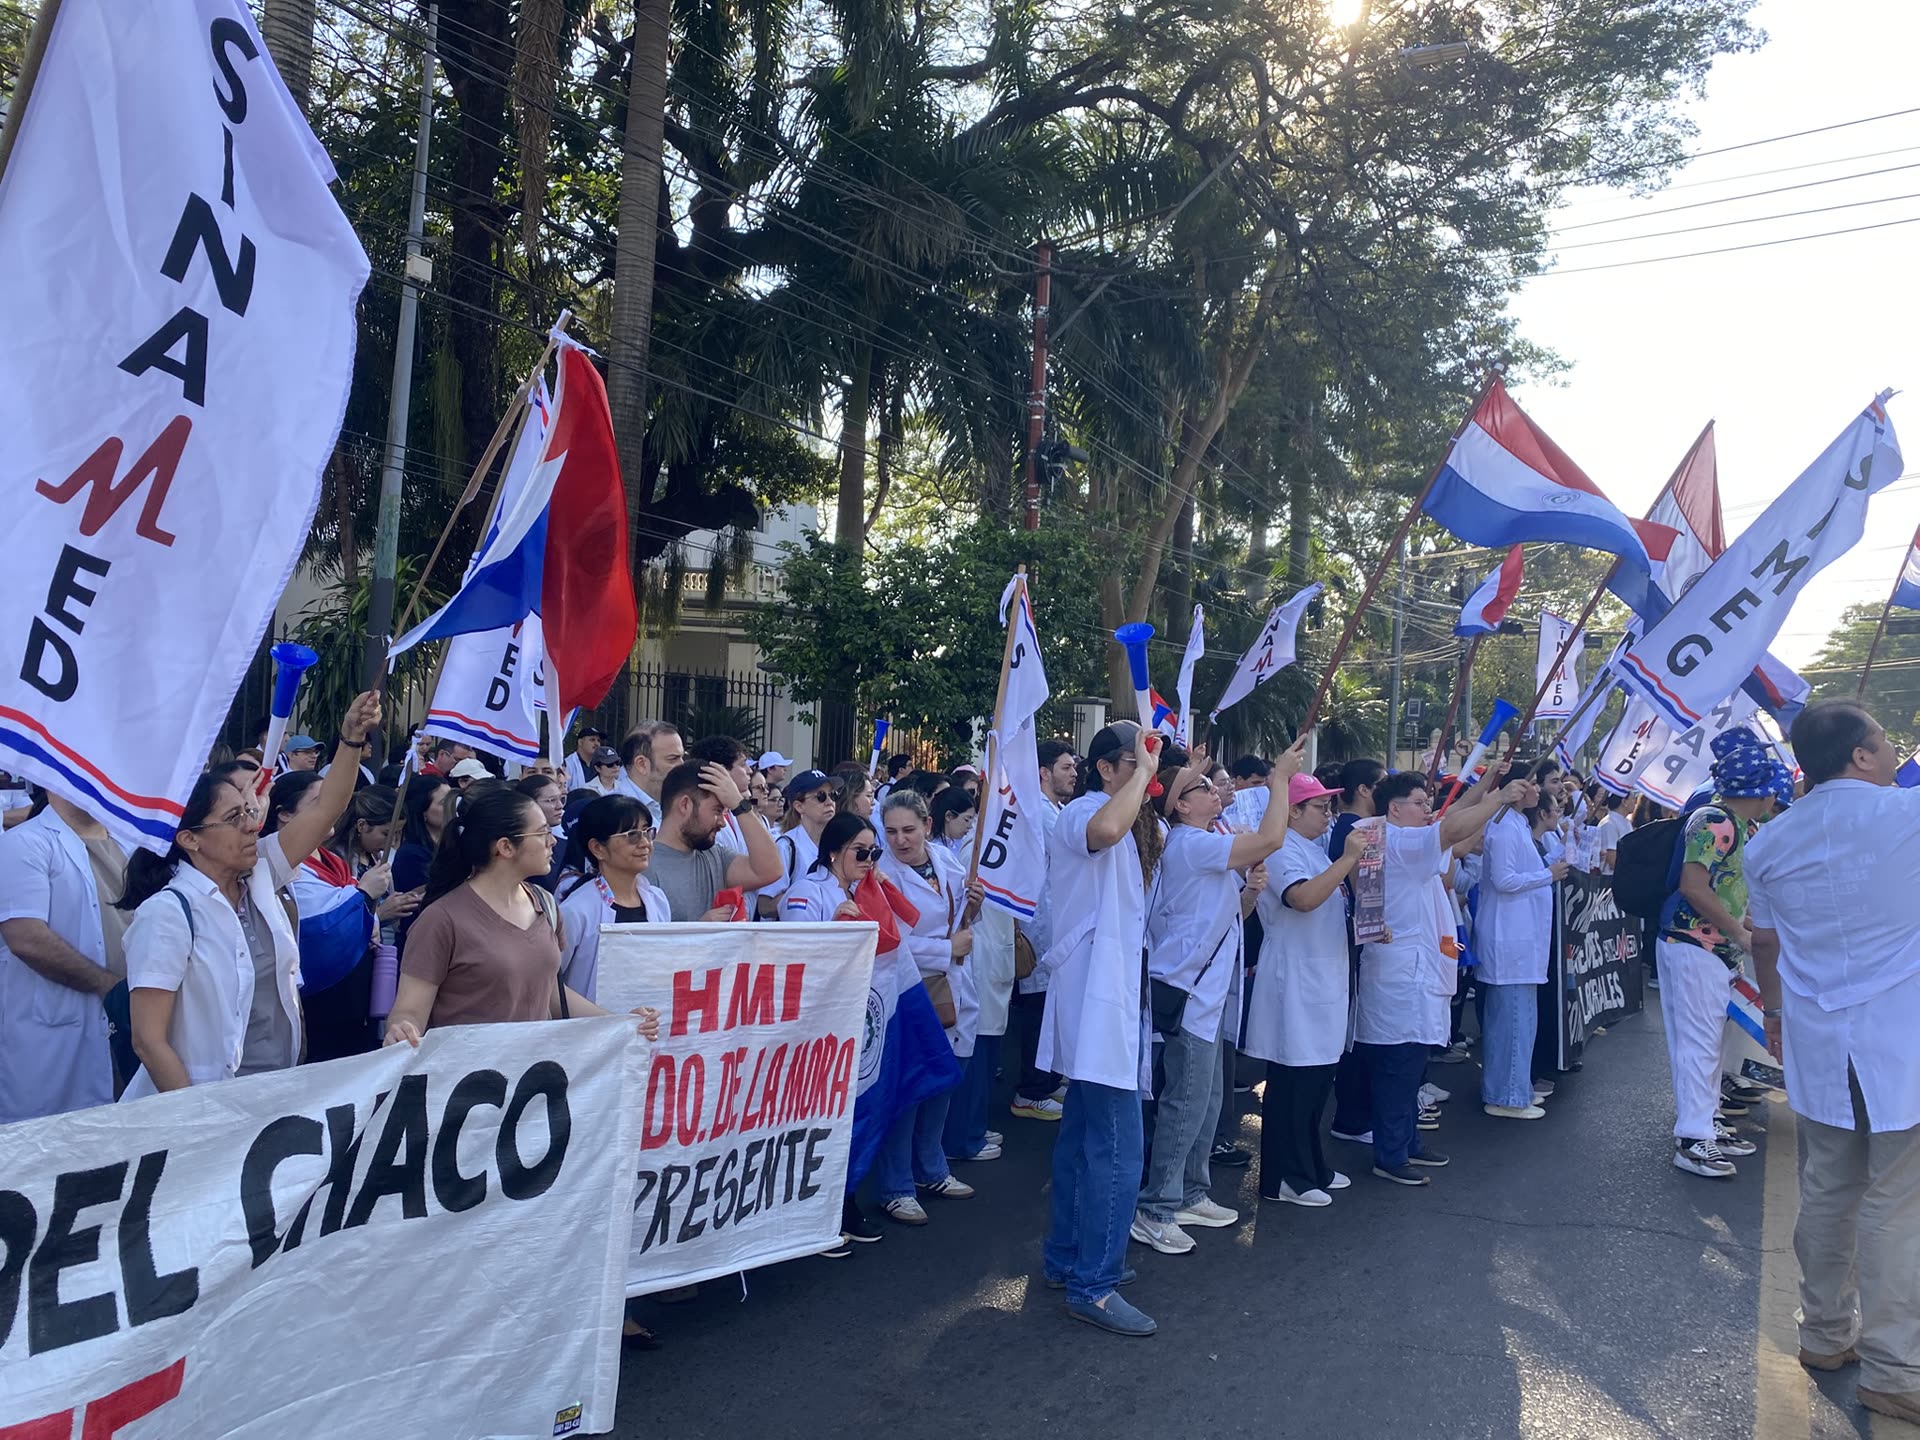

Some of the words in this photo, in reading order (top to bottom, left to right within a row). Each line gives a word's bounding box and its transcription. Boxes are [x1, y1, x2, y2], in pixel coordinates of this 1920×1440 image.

[20, 17, 259, 702] SINAMED
[670, 963, 806, 1036] HMI
[709, 1046, 748, 1141] DE
[739, 1042, 788, 1134] LA
[777, 1032, 856, 1124] MORA
